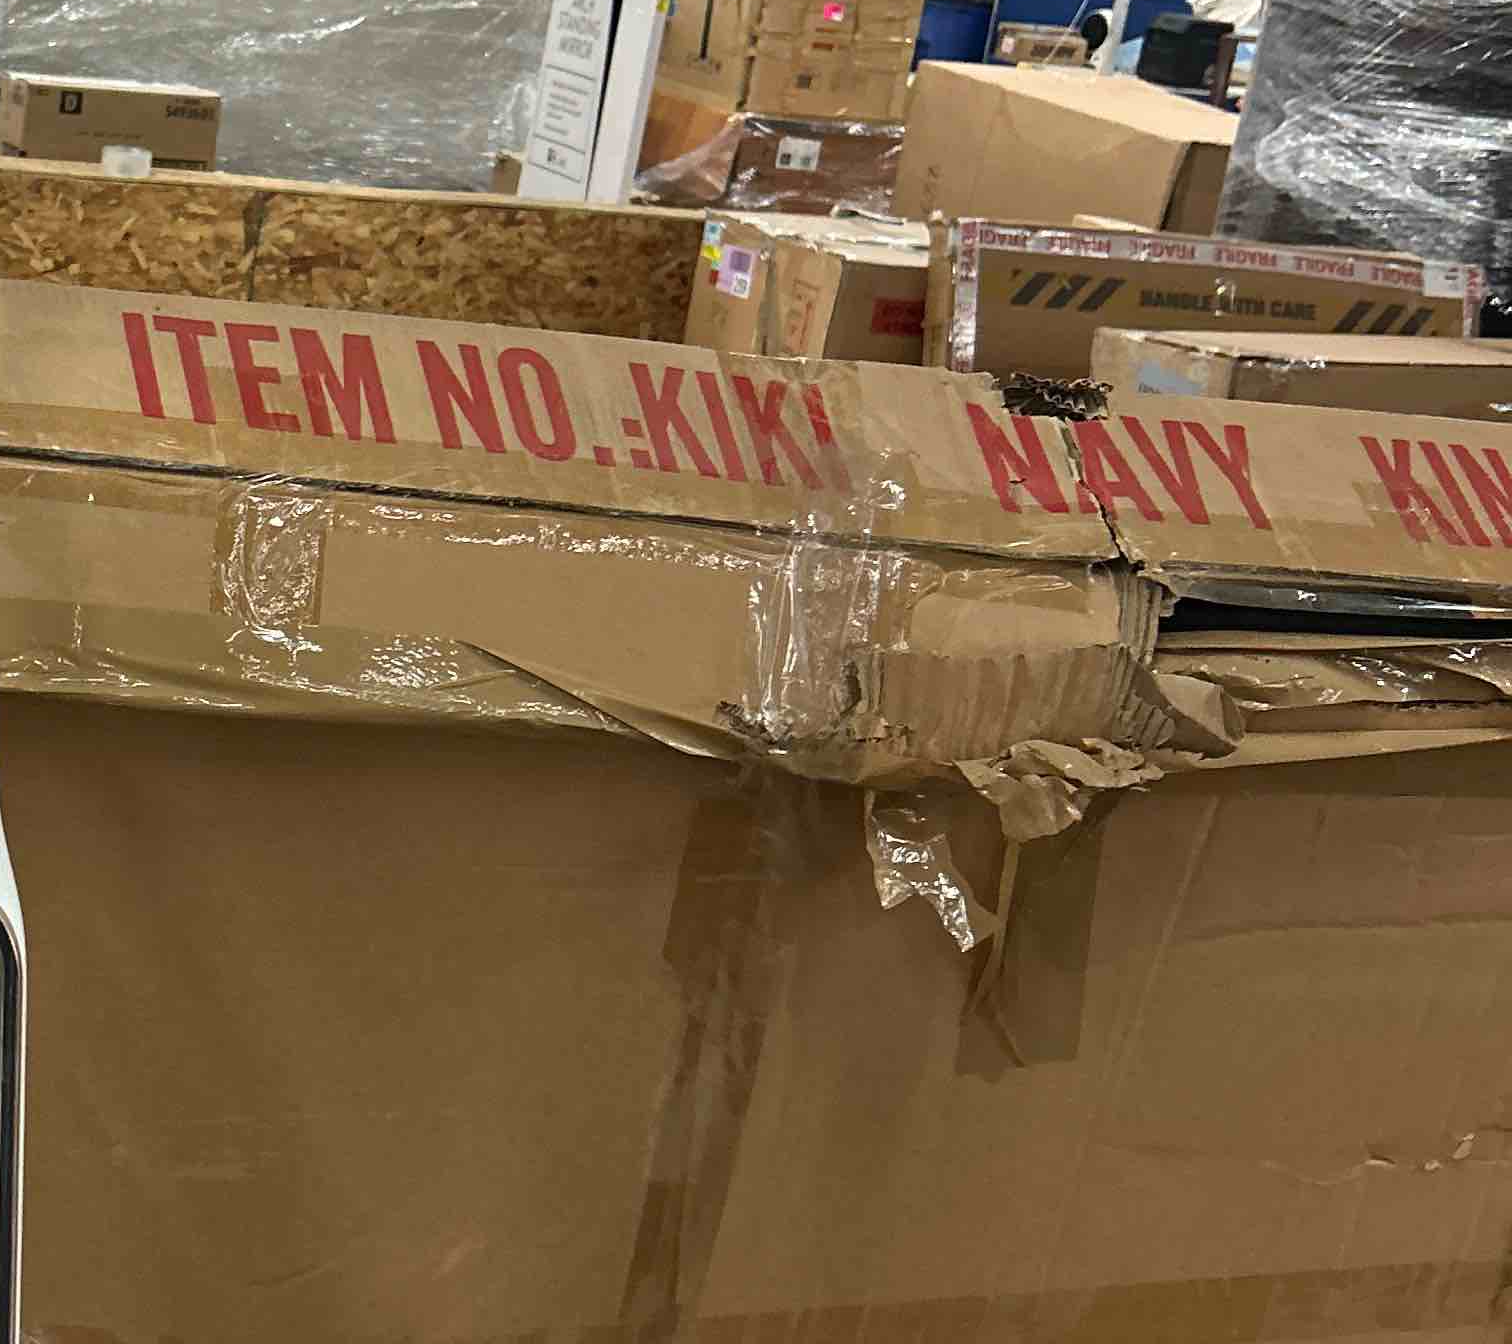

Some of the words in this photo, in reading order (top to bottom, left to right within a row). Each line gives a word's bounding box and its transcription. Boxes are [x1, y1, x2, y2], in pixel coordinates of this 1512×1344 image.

[1270, 301, 1316, 321] CARE
[121, 312, 398, 445] ITEM
[966, 401, 1273, 530] NAVY
